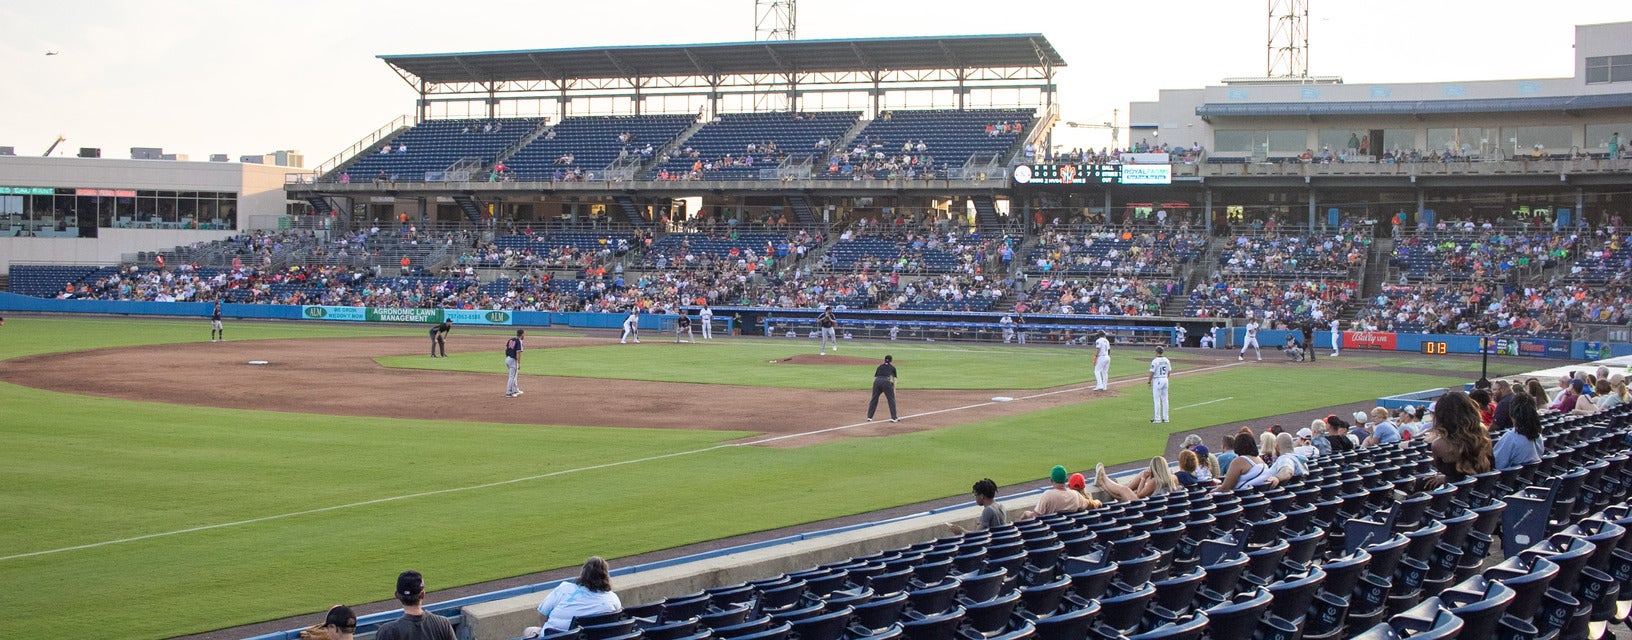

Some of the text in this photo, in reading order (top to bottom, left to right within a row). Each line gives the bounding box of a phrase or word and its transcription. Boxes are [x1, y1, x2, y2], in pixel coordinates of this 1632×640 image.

[310, 308, 322, 316] ALM
[490, 312, 504, 322] ALM
[1160, 366, 1166, 375] 15
